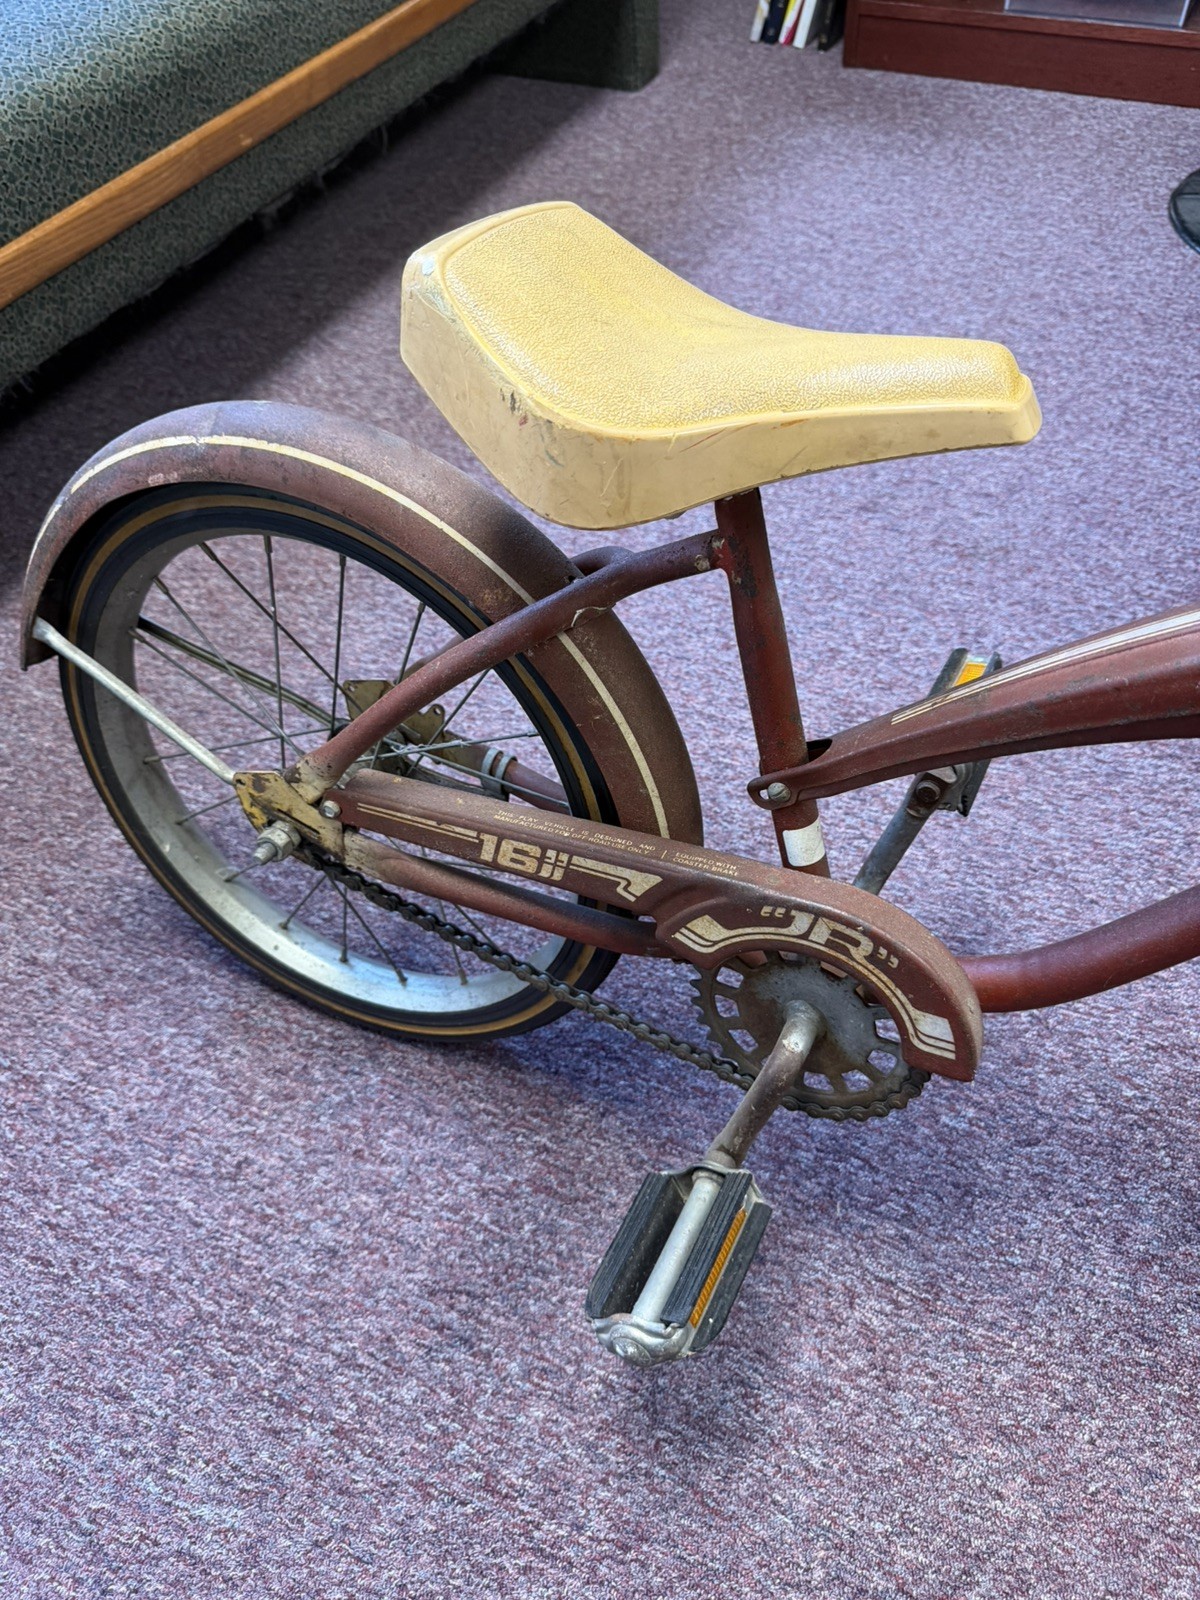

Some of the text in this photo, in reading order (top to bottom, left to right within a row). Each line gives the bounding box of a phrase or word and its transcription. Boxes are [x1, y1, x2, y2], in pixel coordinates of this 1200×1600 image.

[493, 814, 554, 833] MANUFACTURED
[554, 829, 571, 837] FOR
[588, 837, 611, 846] ROAD
[627, 846, 650, 855] ONLY
[497, 810, 514, 818] THIS
[519, 815, 539, 823] PLAY
[544, 821, 576, 832] VEHICLE
[594, 832, 633, 846] DESIGNED
[639, 843, 656, 851] AND
[672, 857, 738, 877] COASTER BRAKE
[675, 852, 737, 870] EQUIPPED WITH
